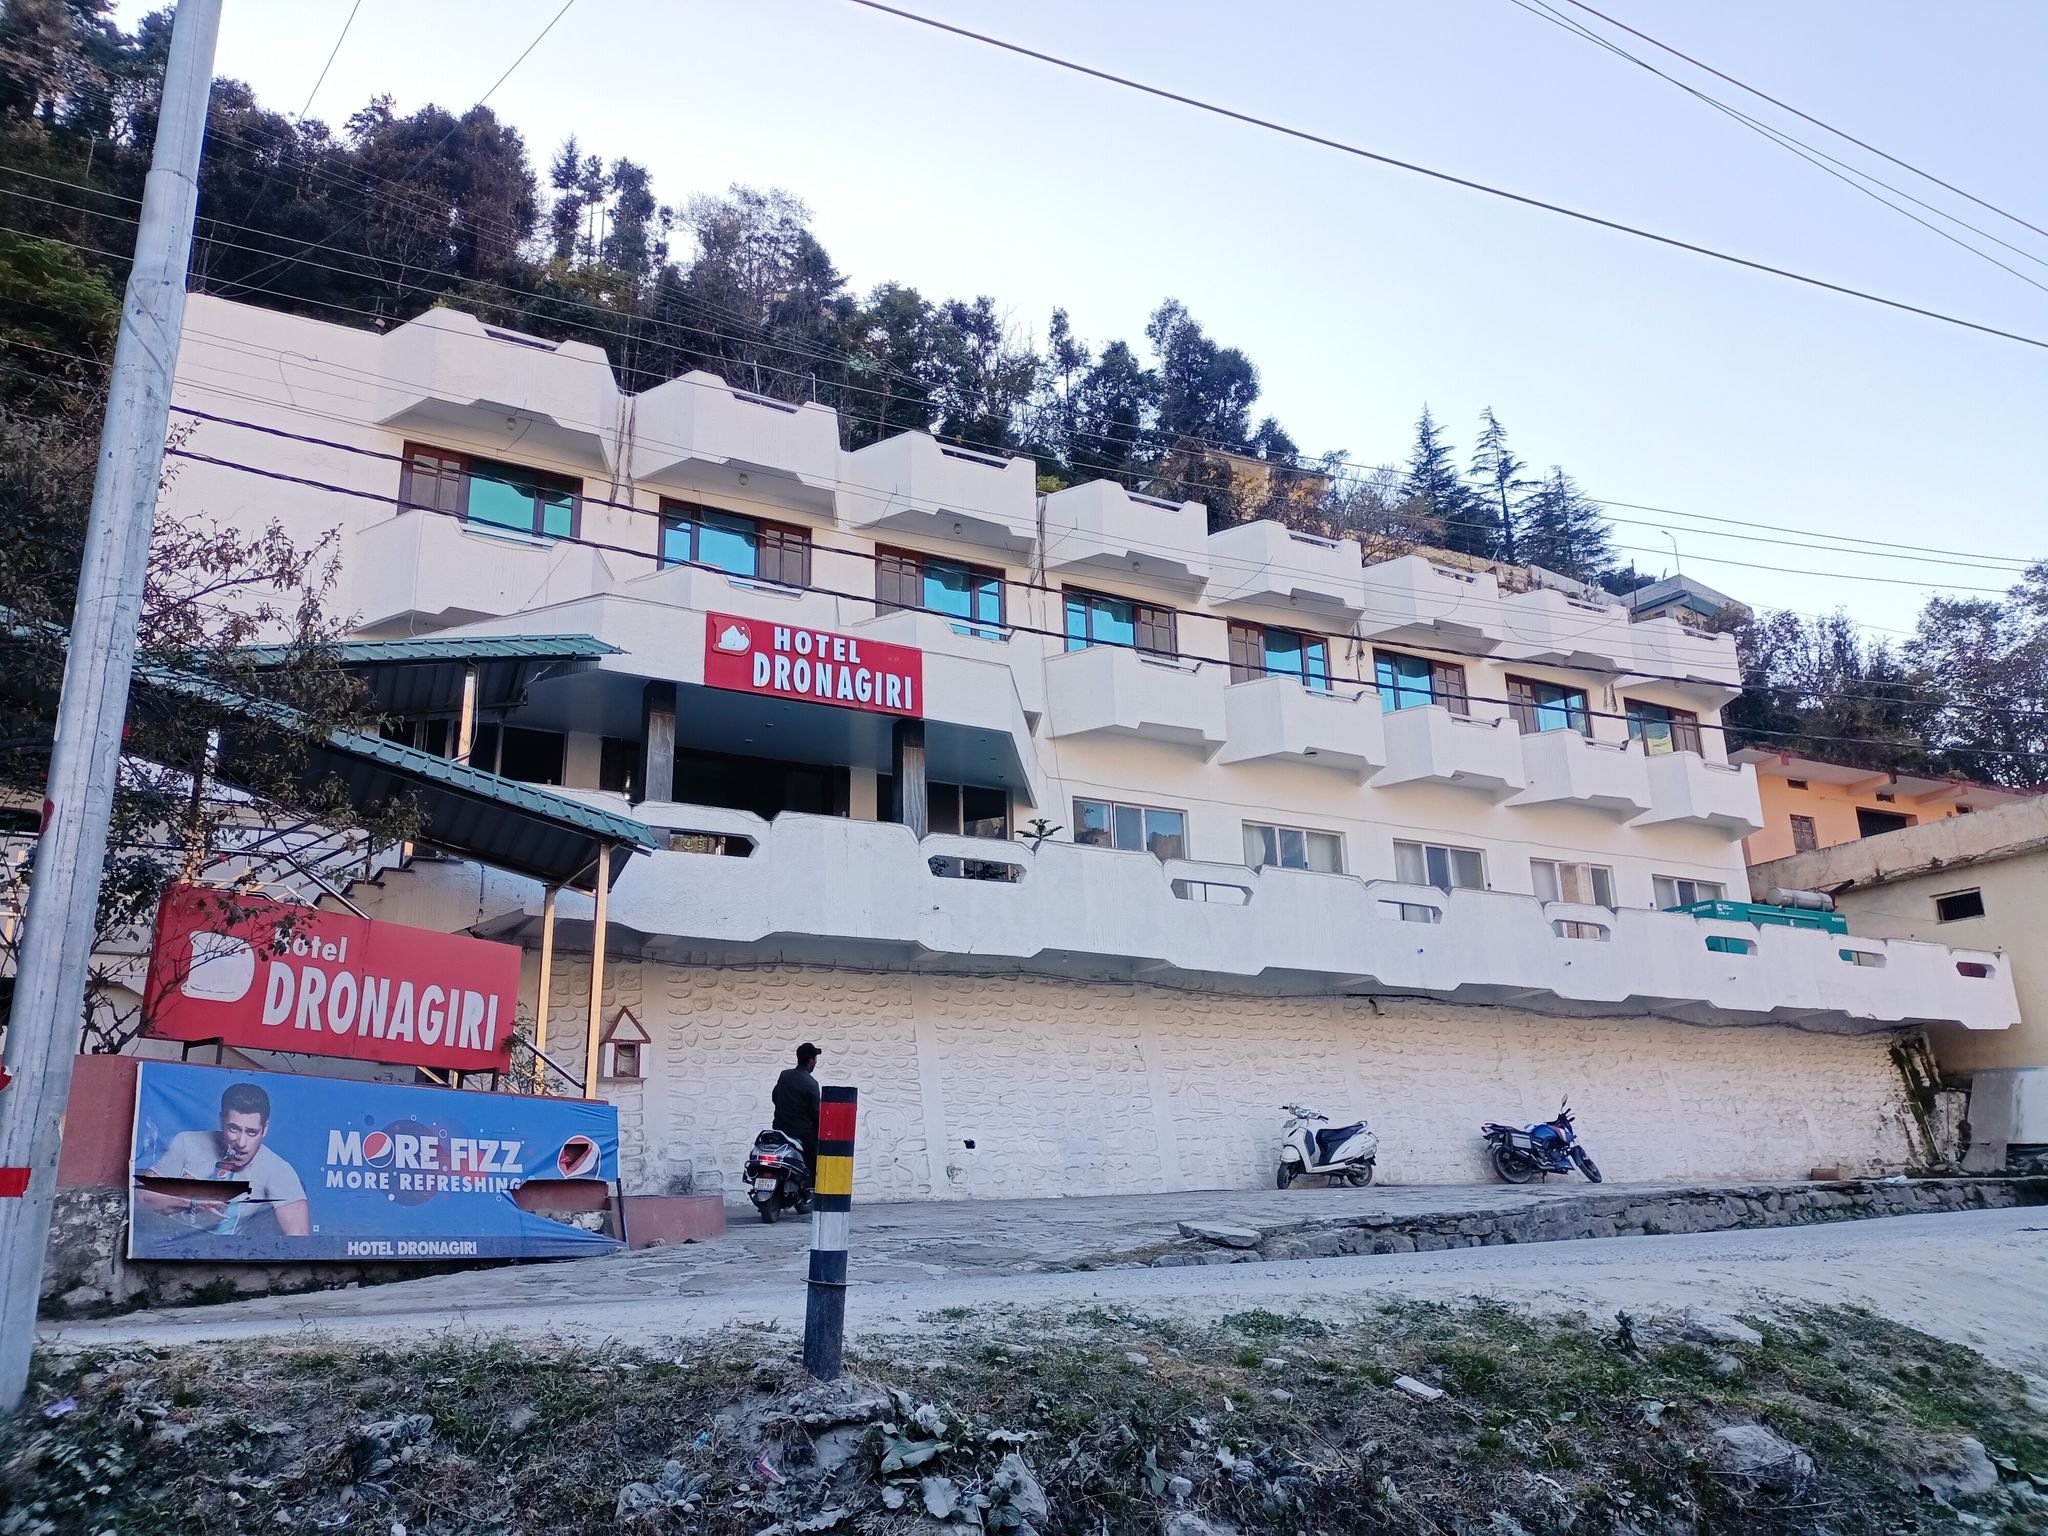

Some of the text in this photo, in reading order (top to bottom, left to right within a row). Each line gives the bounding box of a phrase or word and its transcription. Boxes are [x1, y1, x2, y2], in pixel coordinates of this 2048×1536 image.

[773, 626, 861, 664] HOTEL
[752, 651, 913, 710] DRONAGIRI
[261, 960, 499, 1051] DRONAGIRI
[326, 1129, 524, 1174] MORE FIZZ
[326, 1169, 390, 1190] MORE
[347, 1241, 478, 1257] HOTEL DRONAGIRI
